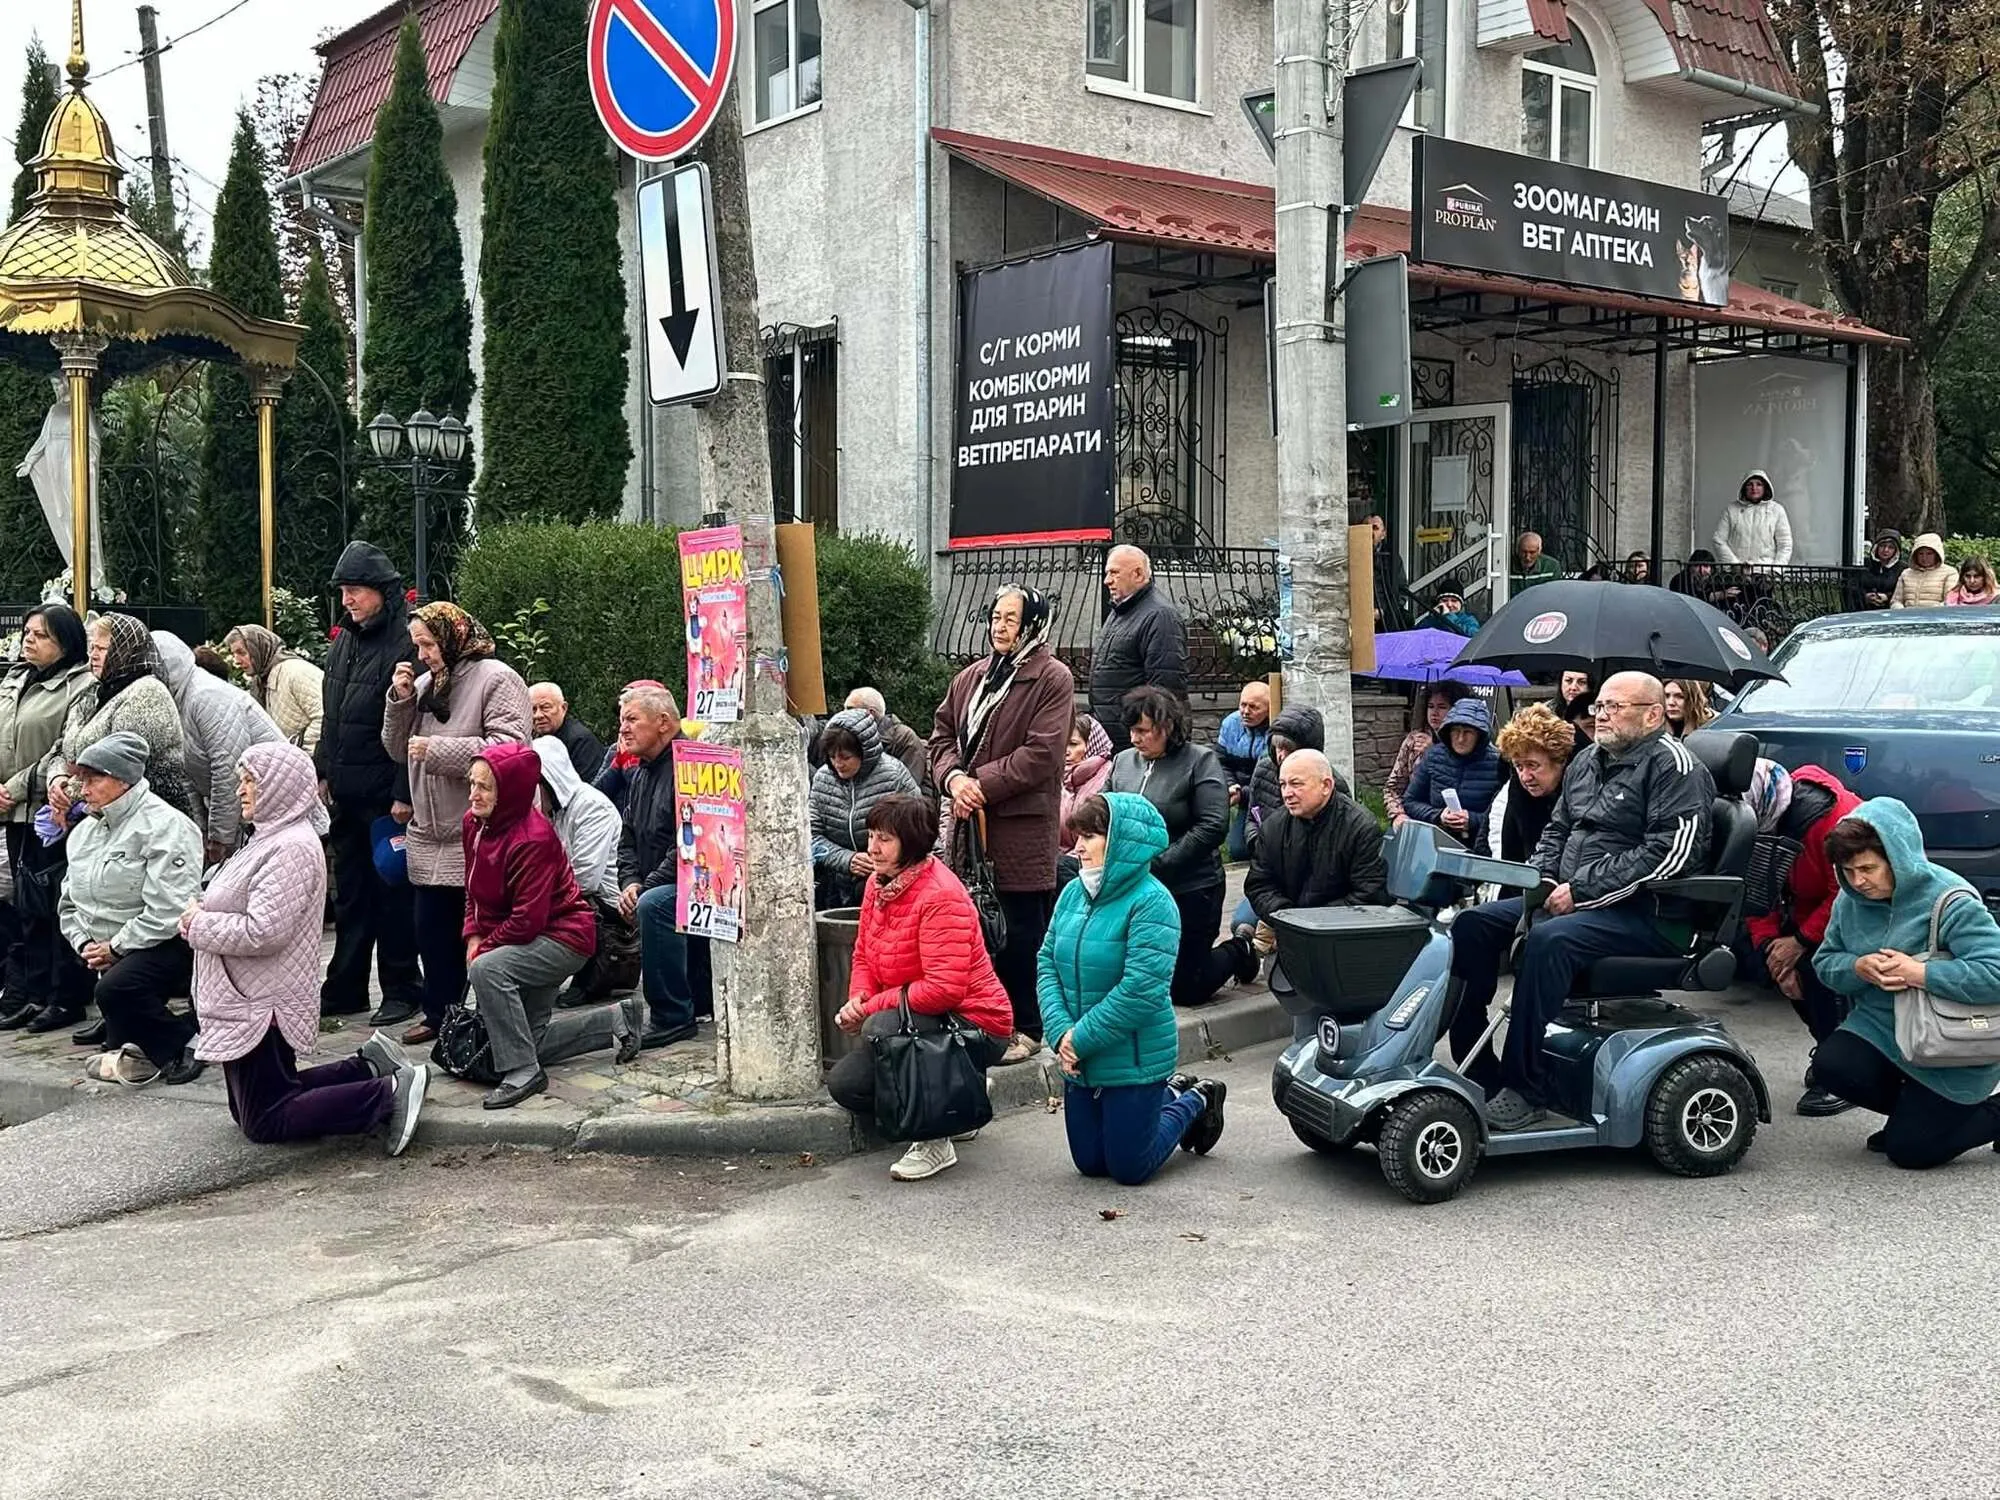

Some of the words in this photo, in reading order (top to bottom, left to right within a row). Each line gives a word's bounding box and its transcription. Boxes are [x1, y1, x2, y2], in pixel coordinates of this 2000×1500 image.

[1513, 182, 1661, 234] ЗООМАГАЗИН
[1522, 222, 1565, 251] ВЕТ
[1571, 231, 1654, 268] АПТЕКА
[979, 337, 1010, 367] С/Г
[1015, 325, 1081, 358] КОРМИ
[969, 361, 1091, 402] КОМБІКОРМИ
[970, 406, 1007, 434] ДЛЯ
[1013, 392, 1086, 423] ТВАРИН
[957, 429, 1102, 467] ВЕТПРЕПАРАТИ
[683, 547, 744, 591] ЦИРК
[696, 690, 714, 714] 27
[677, 761, 743, 801] ЦИРК
[690, 903, 712, 928] 27
